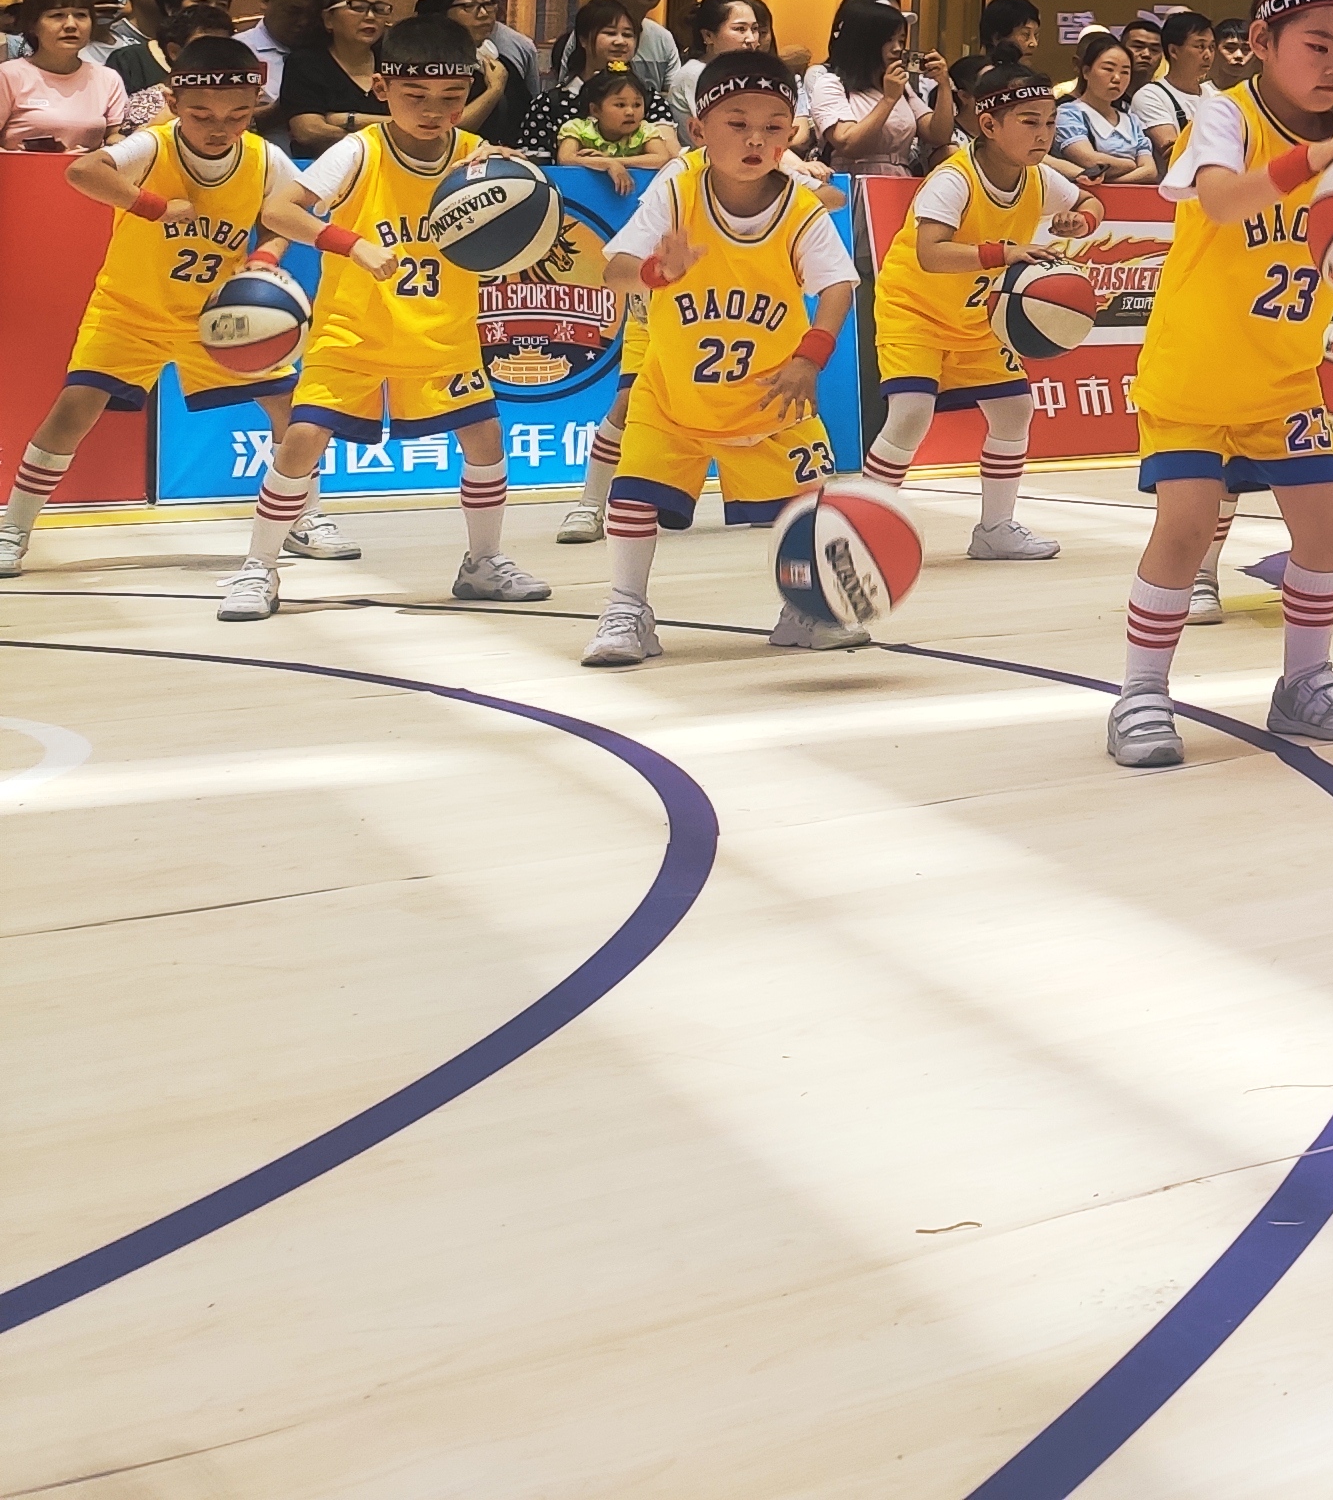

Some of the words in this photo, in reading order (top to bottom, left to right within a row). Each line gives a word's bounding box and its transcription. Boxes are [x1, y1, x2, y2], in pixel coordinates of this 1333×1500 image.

[430, 185, 508, 243] QUANXING
[170, 248, 223, 284] 23
[395, 257, 441, 298] 23
[1088, 266, 1162, 291] BASKET
[507, 283, 570, 311] SPORTS
[573, 287, 617, 322] CLUB
[674, 288, 789, 334] BAOBO
[1251, 264, 1321, 323] 23
[512, 336, 549, 346] 2005
[693, 337, 756, 385] 23
[1285, 405, 1332, 453] 23
[788, 441, 835, 485] 23
